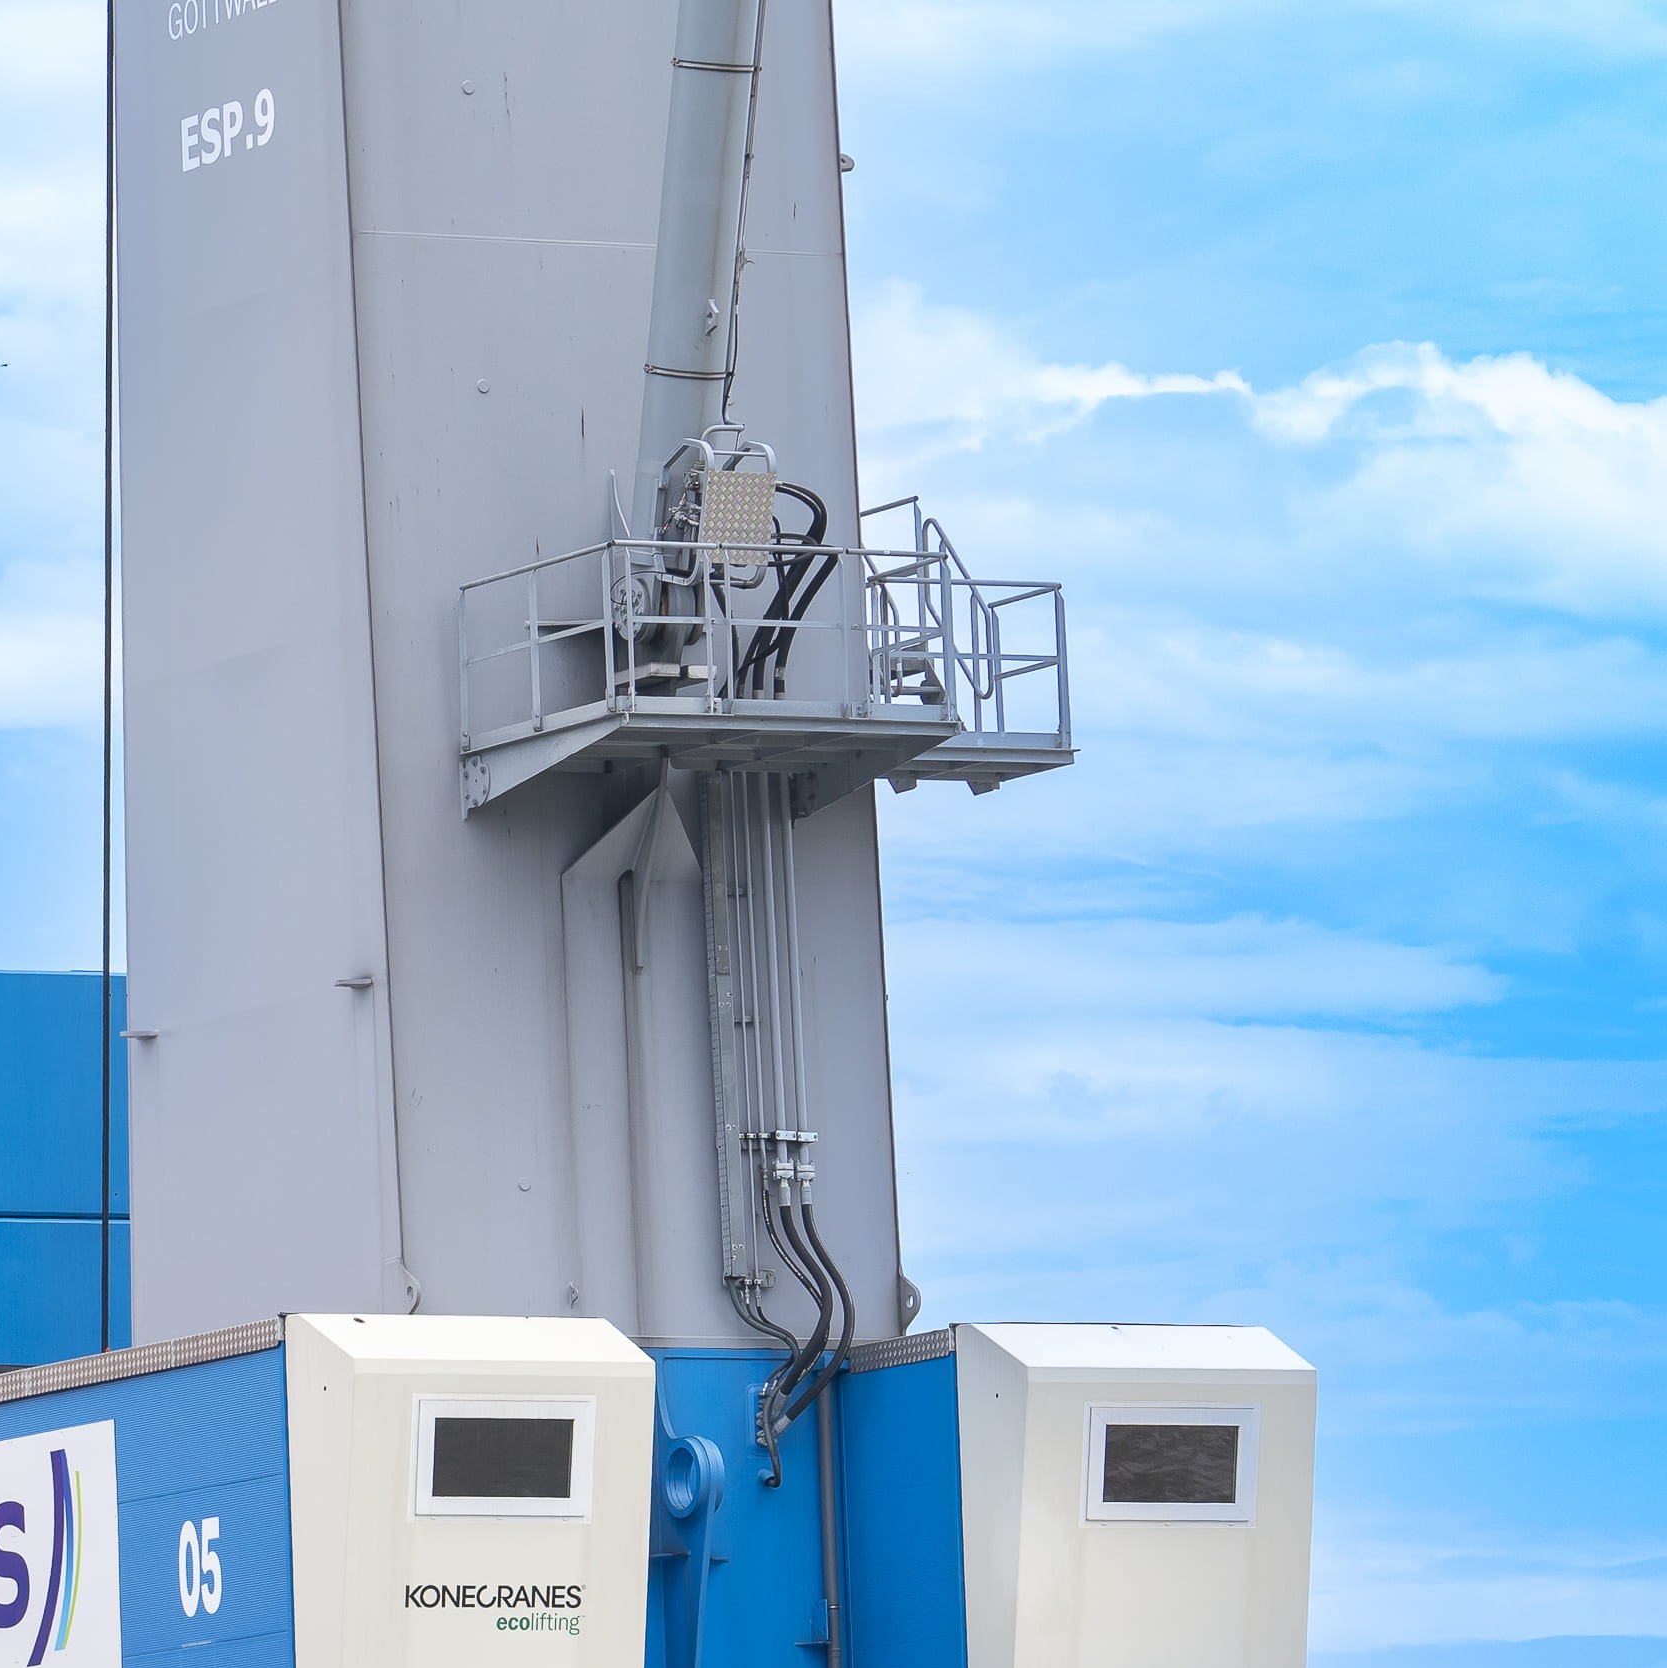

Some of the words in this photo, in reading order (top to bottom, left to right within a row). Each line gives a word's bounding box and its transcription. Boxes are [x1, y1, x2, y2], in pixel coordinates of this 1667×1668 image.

[168, 0, 279, 40] GOTTW
[180, 88, 276, 173] ESP.9
[179, 1516, 223, 1618] 05
[404, 1584, 582, 1608] KONECRANES
[496, 1612, 580, 1636] ecolifting
